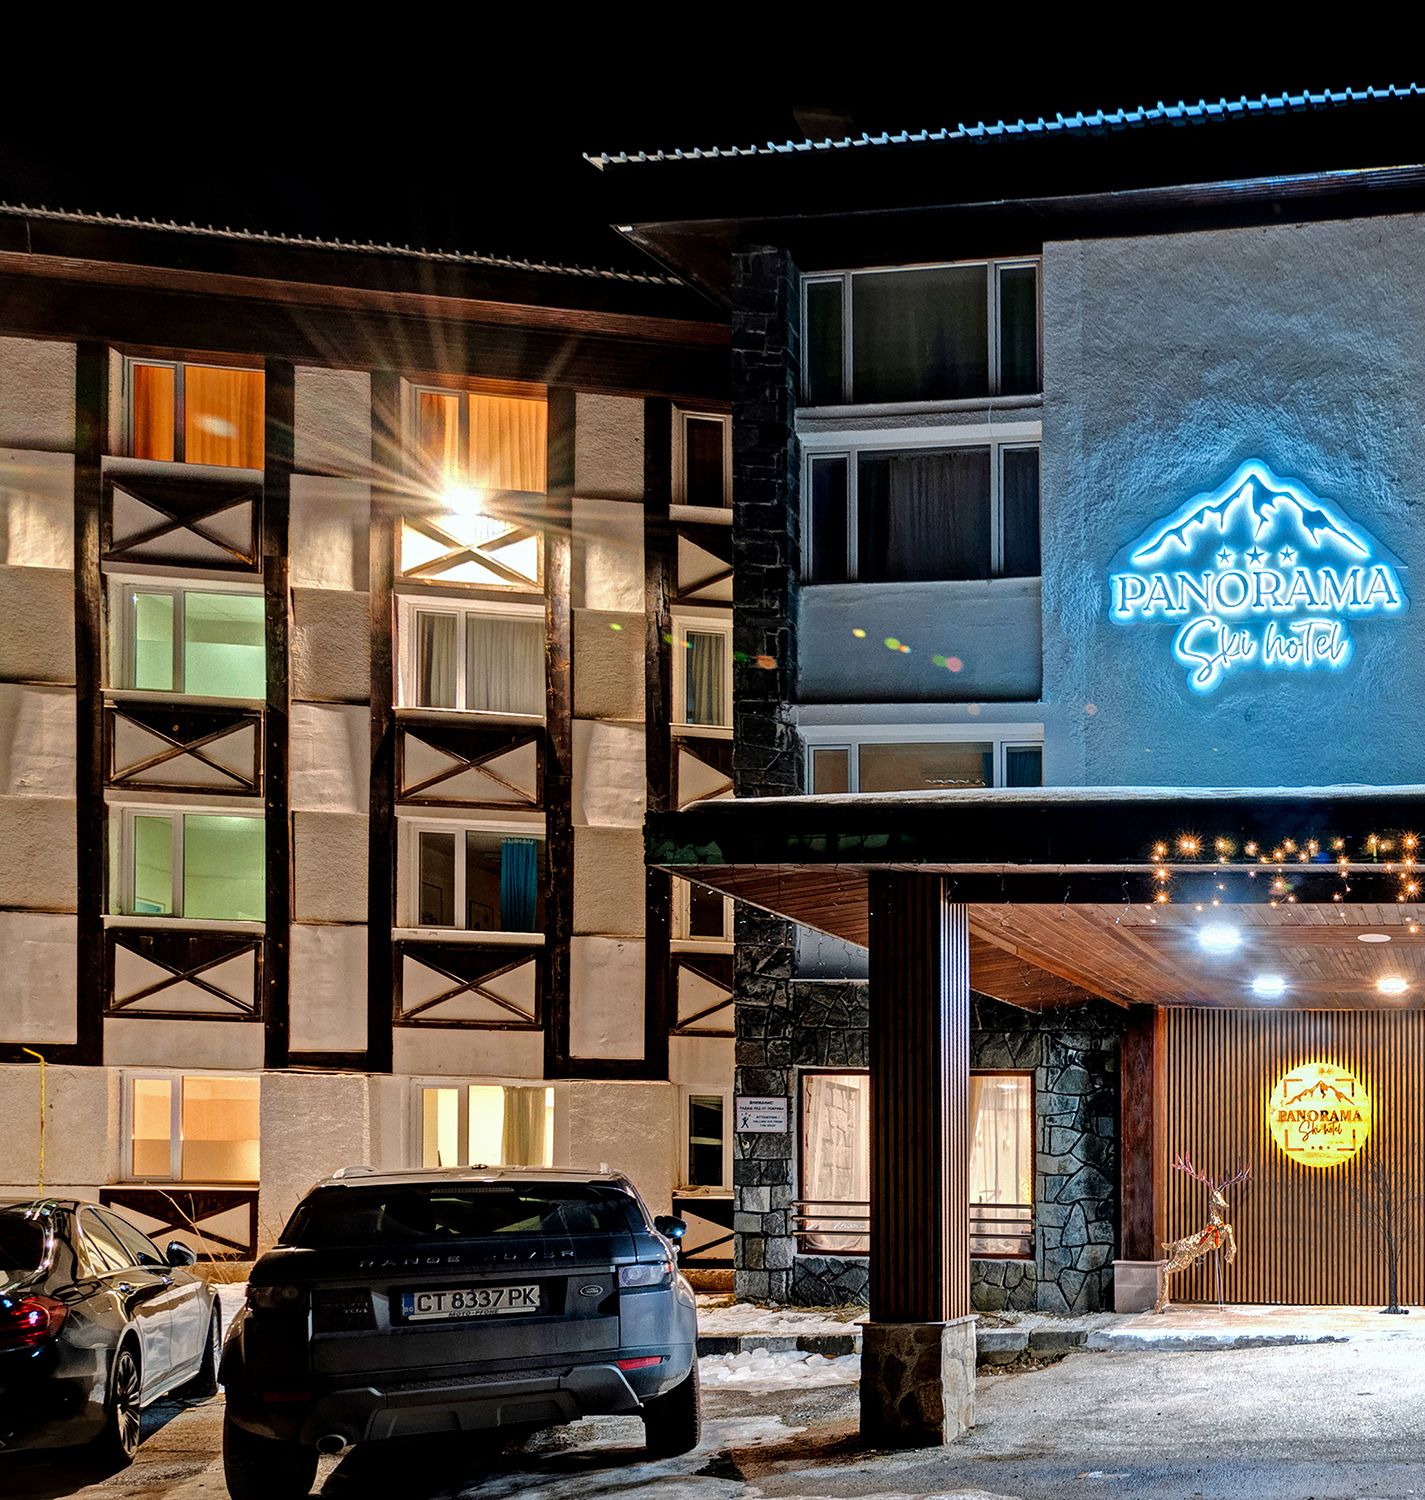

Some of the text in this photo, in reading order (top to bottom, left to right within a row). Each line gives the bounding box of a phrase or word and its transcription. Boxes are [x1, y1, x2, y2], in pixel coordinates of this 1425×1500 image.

[1117, 567, 1398, 612] PANORAMA
[1178, 618, 1254, 683] Ski
[1277, 1110, 1362, 1122] PANORAMA
[1298, 1120, 1321, 1141] Ski
[417, 1287, 536, 1312] CT 8337 PK
